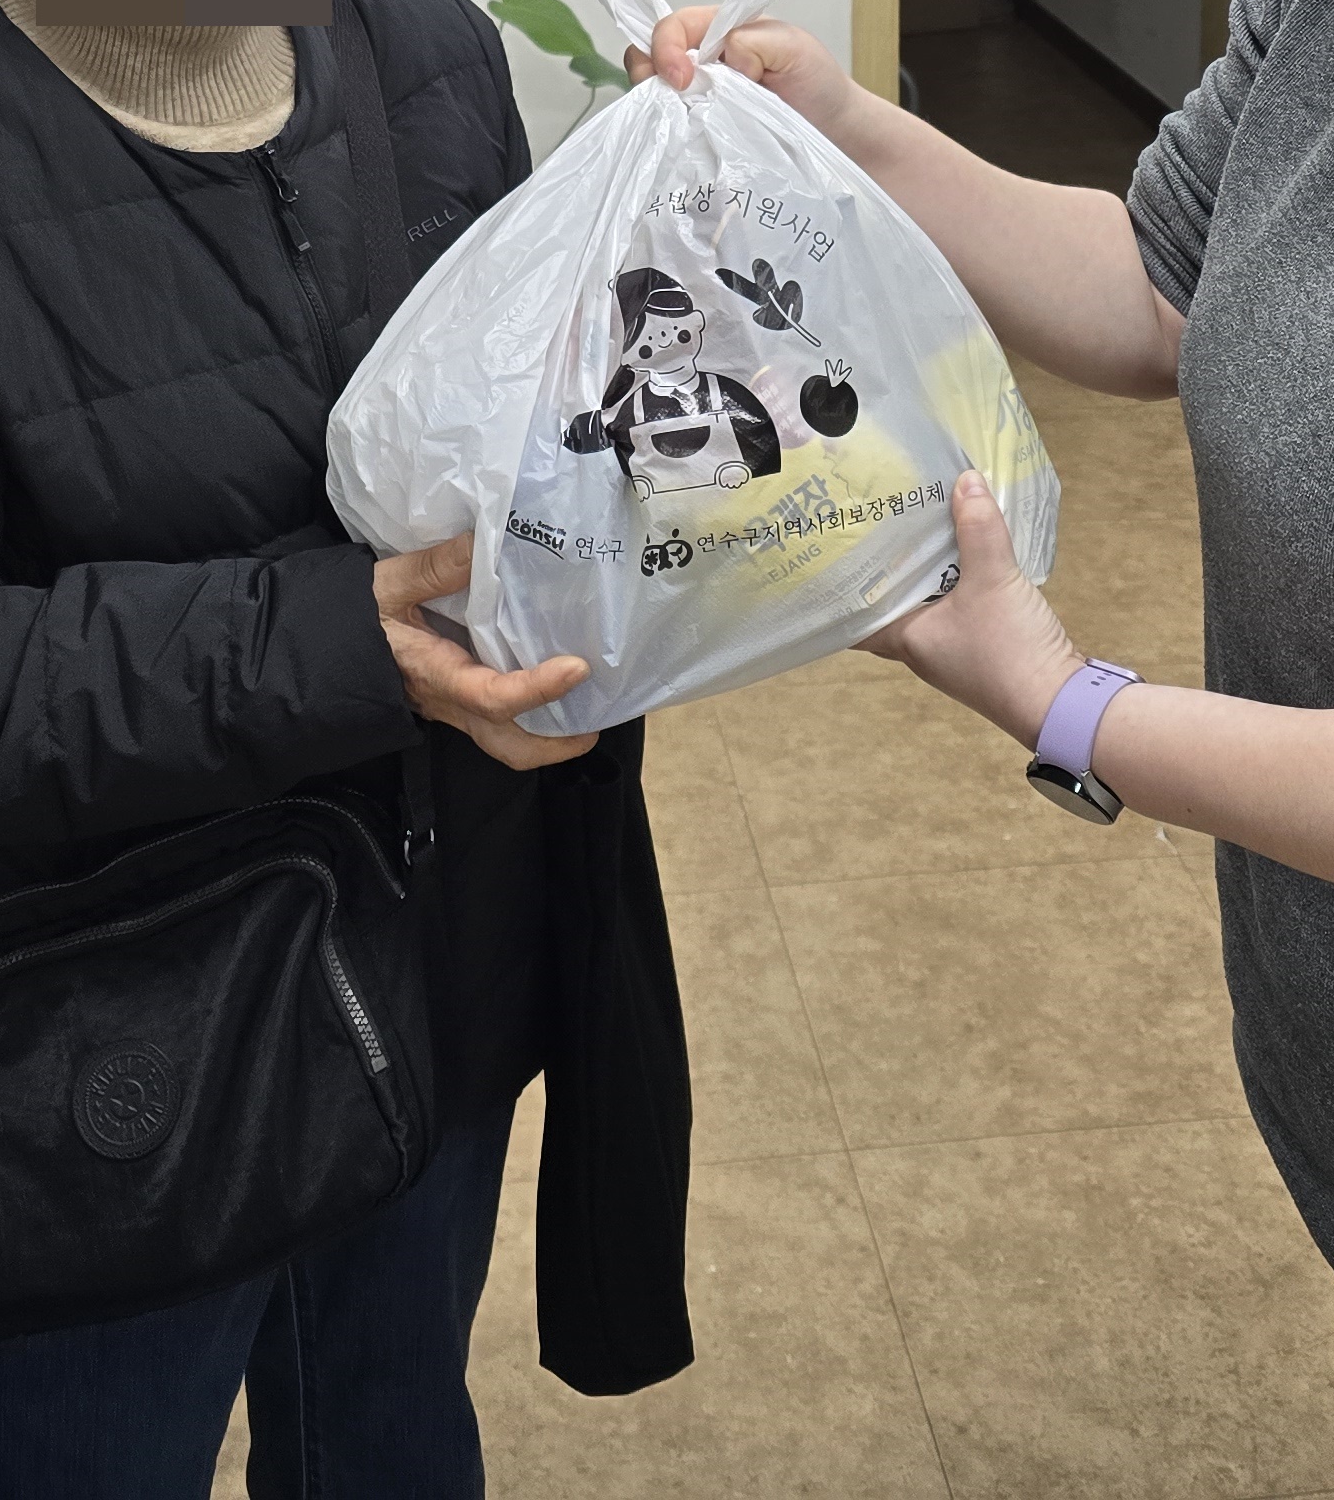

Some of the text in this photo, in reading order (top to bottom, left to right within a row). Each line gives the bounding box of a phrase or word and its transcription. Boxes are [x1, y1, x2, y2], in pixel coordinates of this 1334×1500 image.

[407, 209, 458, 242] RELL
[725, 188, 835, 263] 지원사업
[696, 480, 946, 553] 연수구지역사회보장협의체
[575, 536, 625, 562] 연수구
